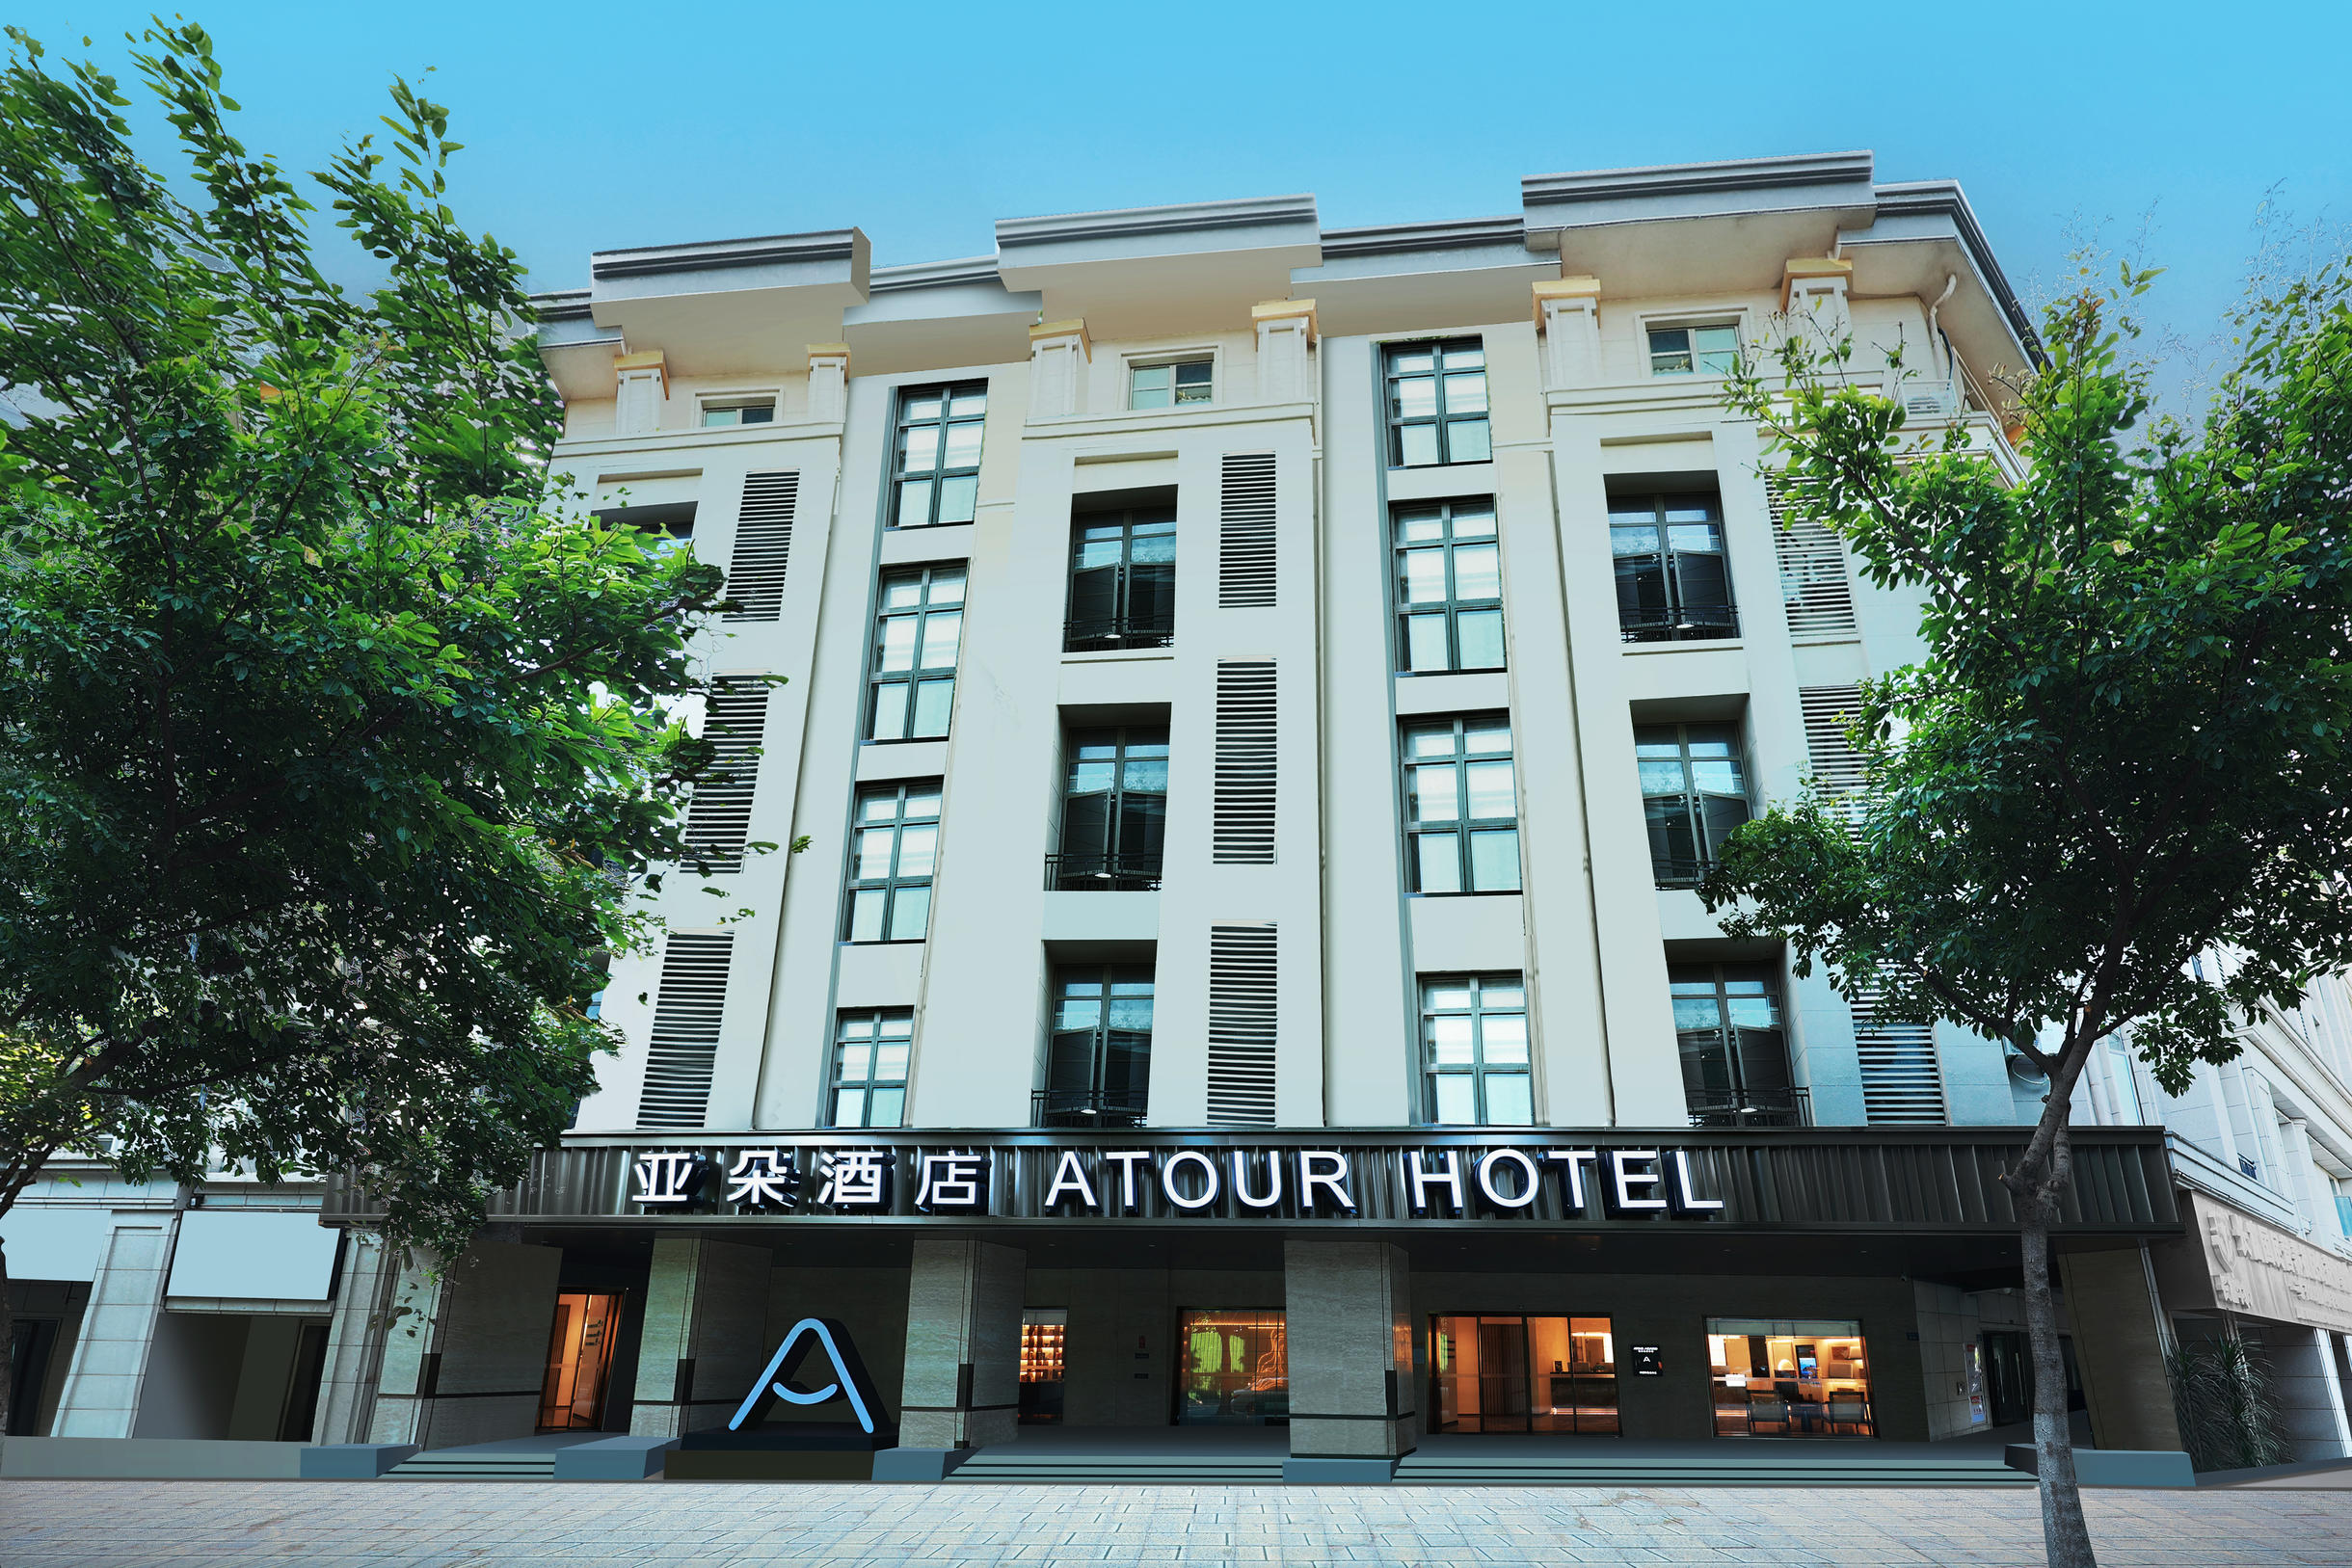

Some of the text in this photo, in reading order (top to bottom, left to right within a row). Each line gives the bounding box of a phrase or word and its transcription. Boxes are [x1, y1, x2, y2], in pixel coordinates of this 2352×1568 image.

[631, 1150, 978, 1207] 亚朵酒店
[1045, 1148, 1724, 1209] ATOUR HOTEL
[728, 1317, 874, 1434] A
